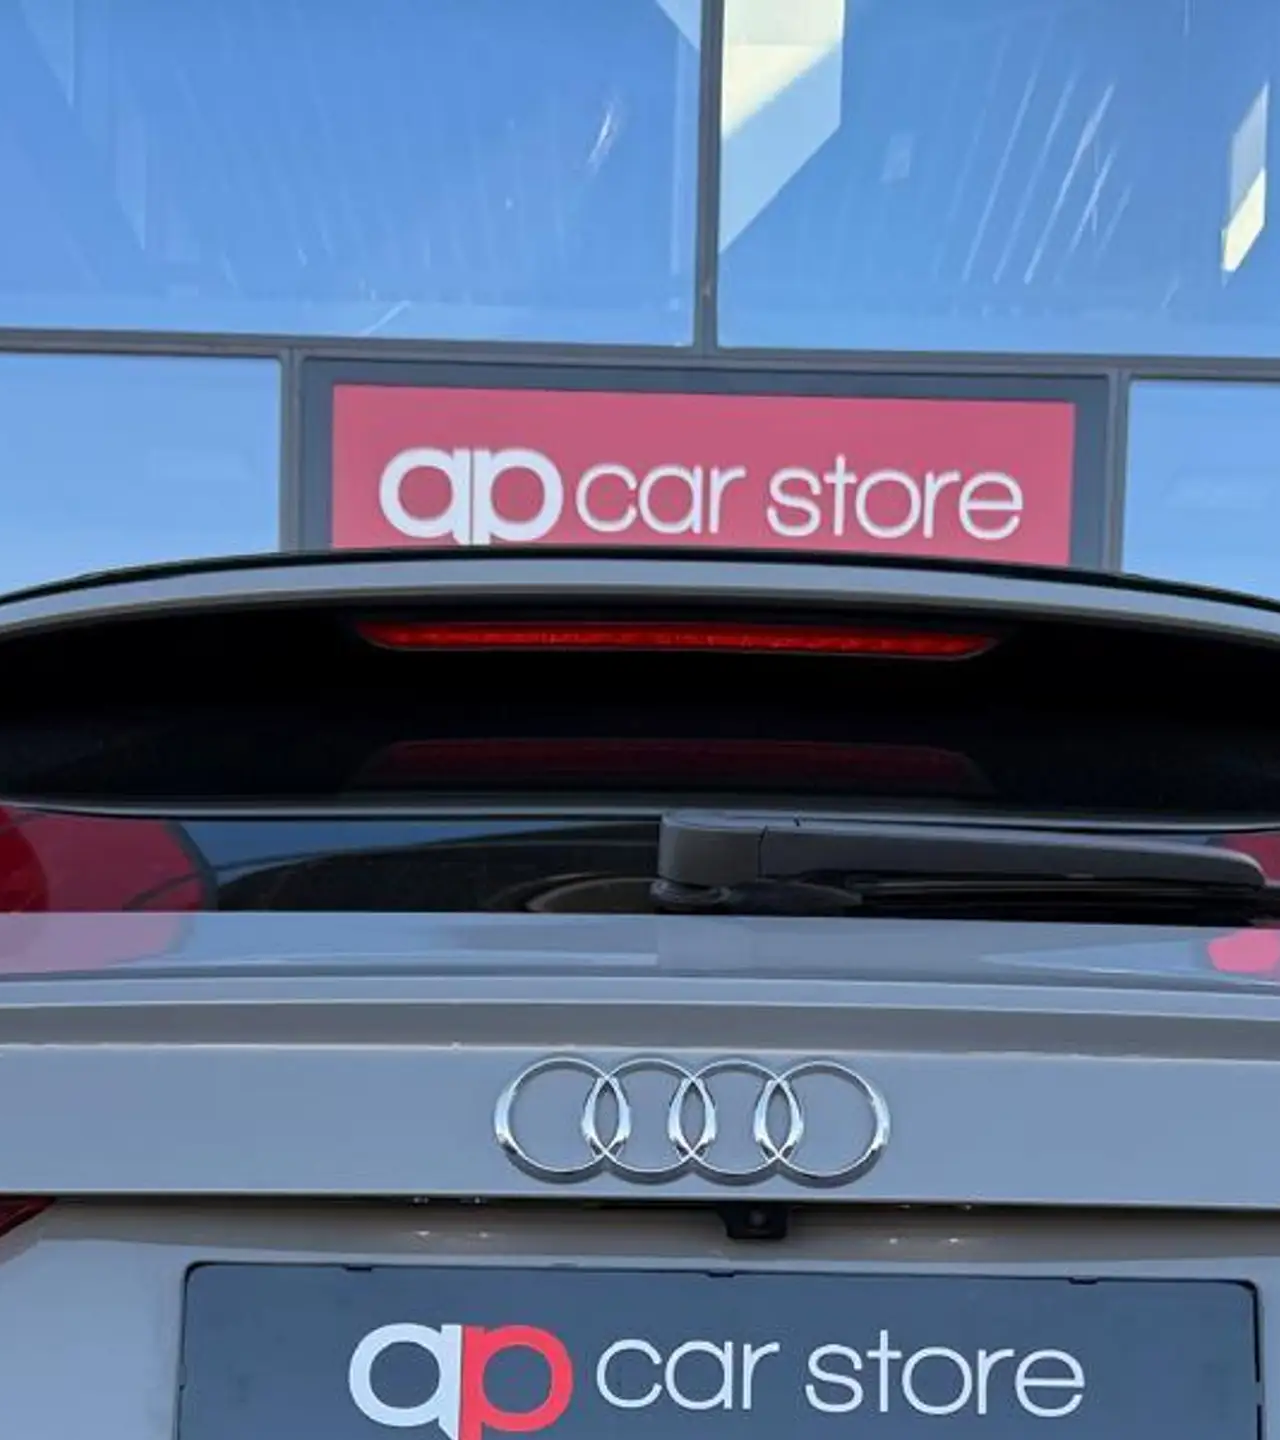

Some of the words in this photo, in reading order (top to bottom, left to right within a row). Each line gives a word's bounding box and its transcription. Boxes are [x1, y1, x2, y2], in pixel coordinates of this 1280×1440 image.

[379, 447, 564, 546] ap
[576, 464, 746, 534] car
[766, 455, 1024, 540] store
[597, 1339, 780, 1409] car
[805, 1330, 1086, 1417] store
